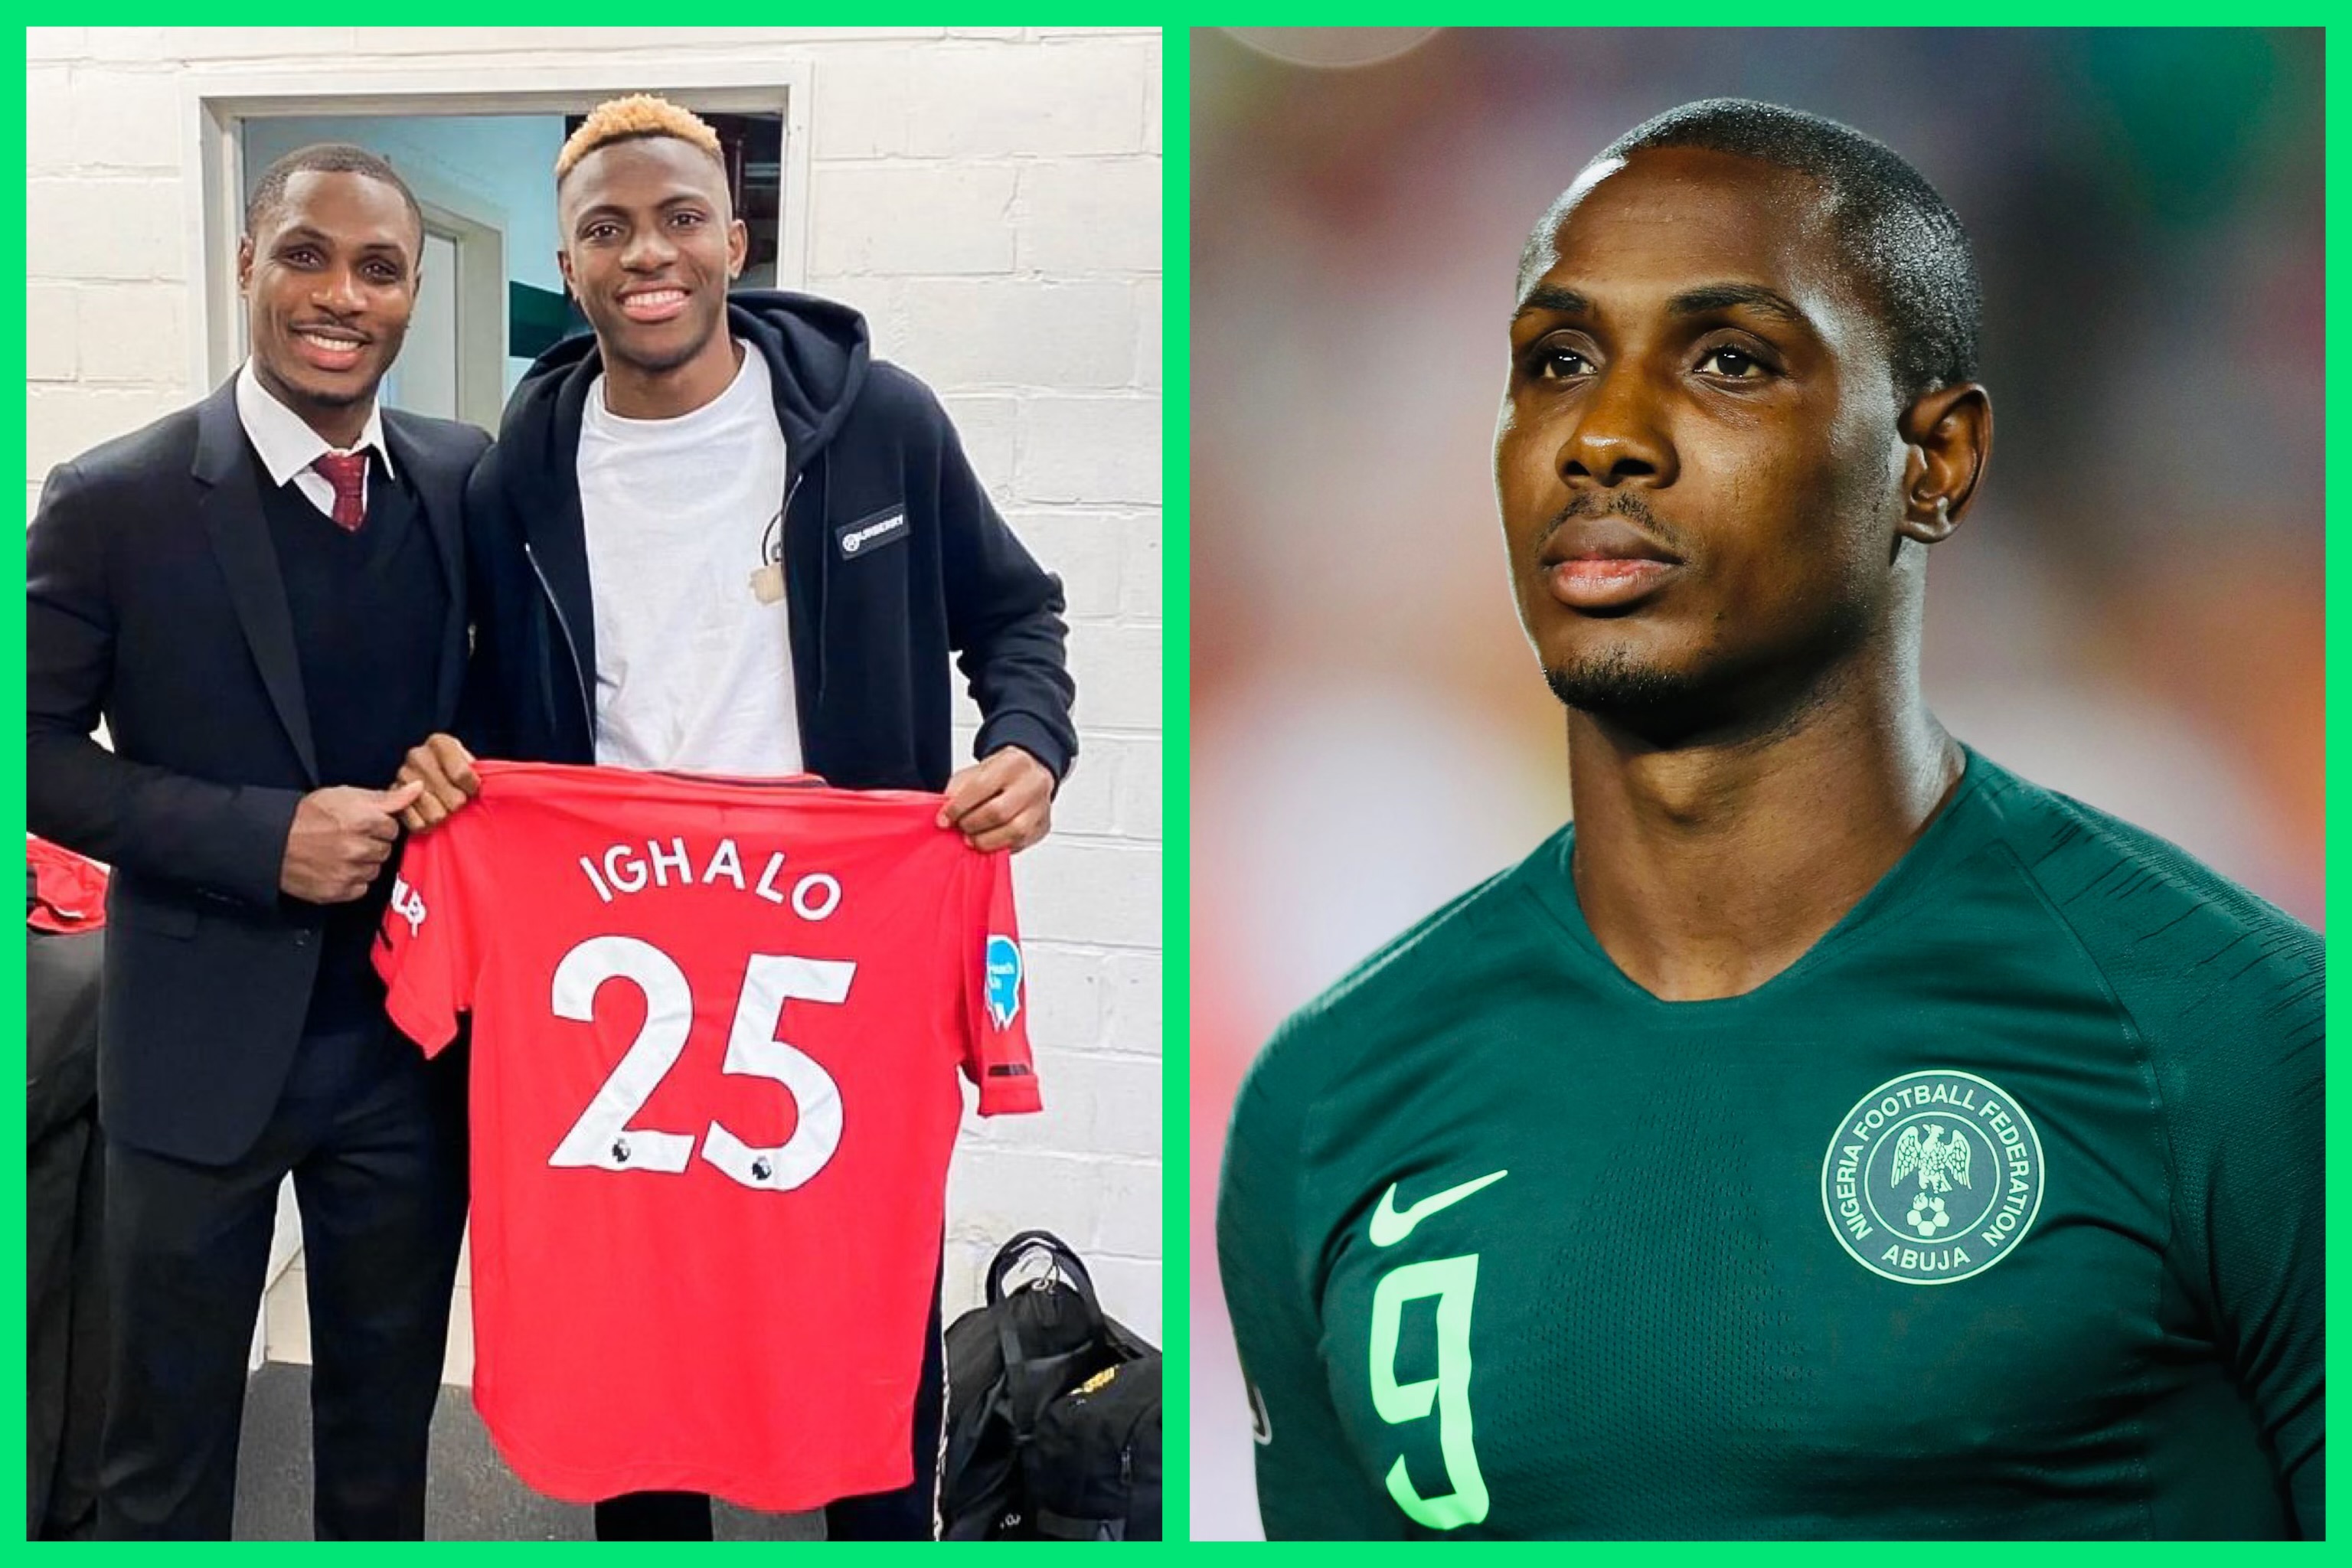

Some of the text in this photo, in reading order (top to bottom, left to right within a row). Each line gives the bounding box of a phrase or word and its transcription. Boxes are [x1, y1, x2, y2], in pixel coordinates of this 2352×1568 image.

[580, 837, 843, 922] IGHALO
[547, 936, 858, 1192] 25
[1836, 1083, 2030, 1248] NIGERIA FOOTBALL FEDERATION
[1880, 1244, 1971, 1272] ABUJA
[1369, 1253, 1490, 1530] 9
